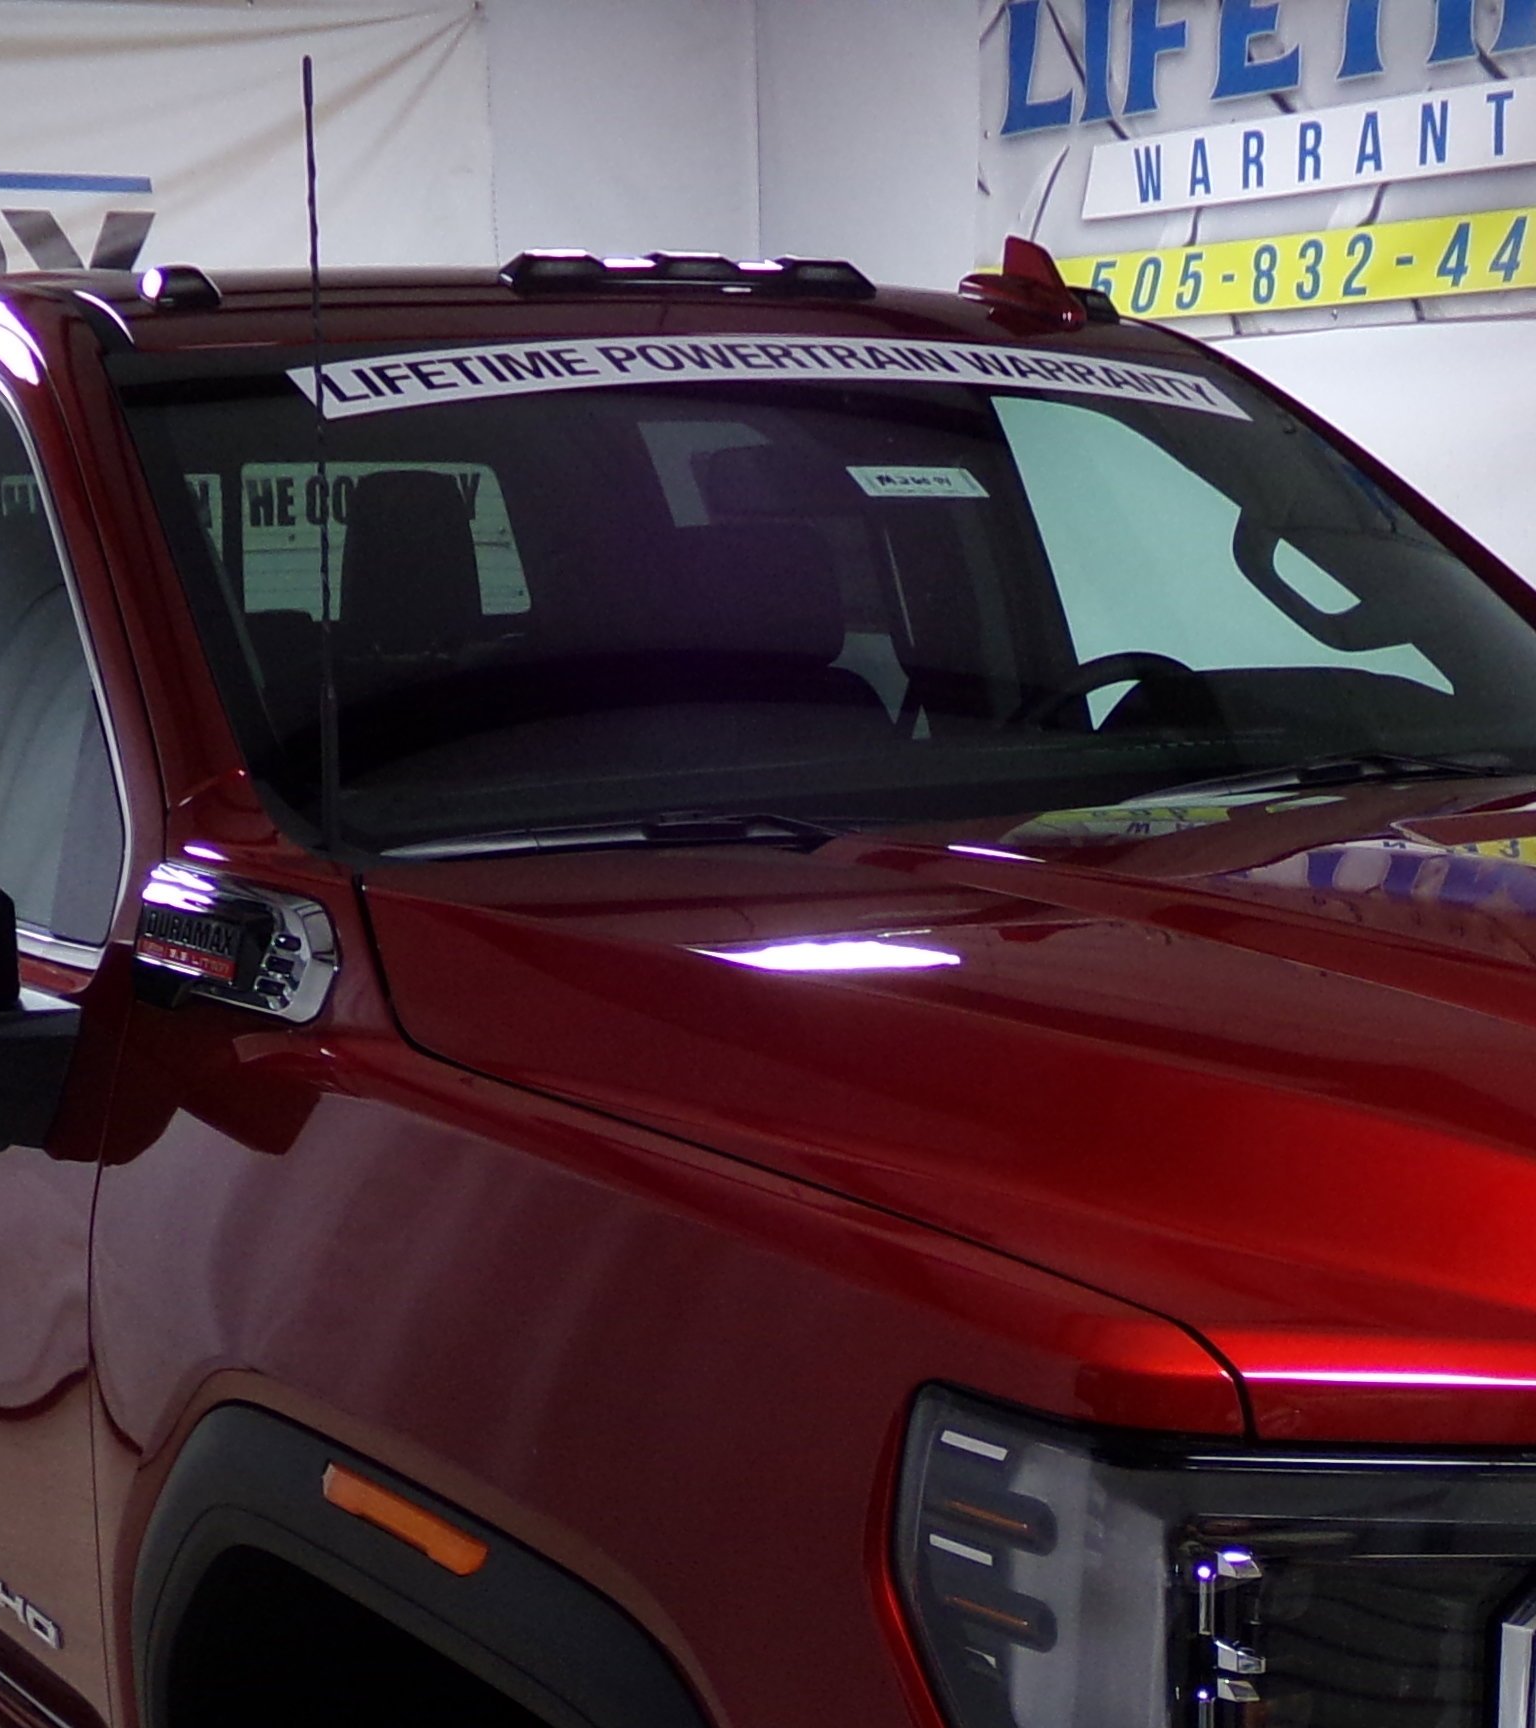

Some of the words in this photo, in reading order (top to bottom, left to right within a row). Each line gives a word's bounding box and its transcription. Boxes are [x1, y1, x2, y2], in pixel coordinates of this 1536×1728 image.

[319, 346, 600, 403] LIFETIME
[596, 343, 959, 374] POWERTRAIN
[953, 350, 1219, 405] WARRANTY
